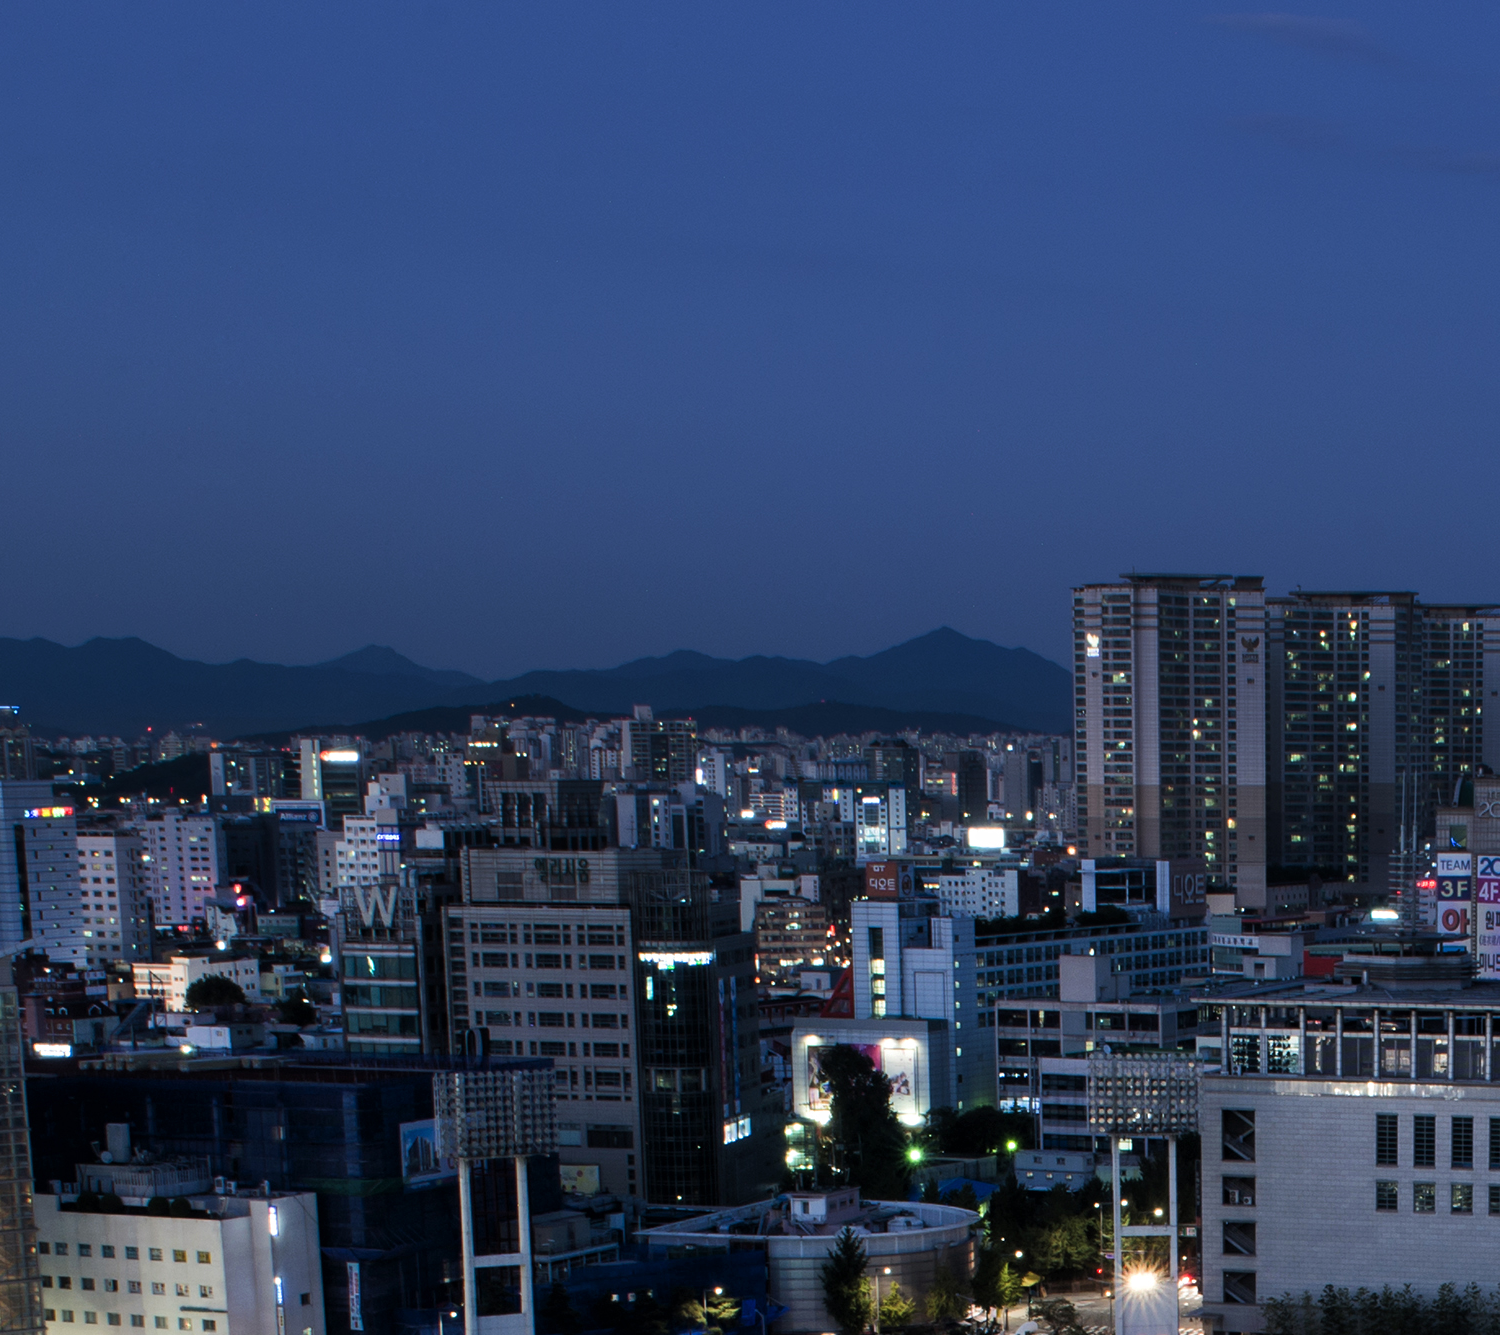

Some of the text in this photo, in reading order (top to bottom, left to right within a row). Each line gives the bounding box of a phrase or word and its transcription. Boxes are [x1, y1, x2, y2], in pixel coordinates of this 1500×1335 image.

[279, 812, 307, 821] Allianz
[1439, 859, 1471, 871] TEAM
[353, 884, 398, 929] W
